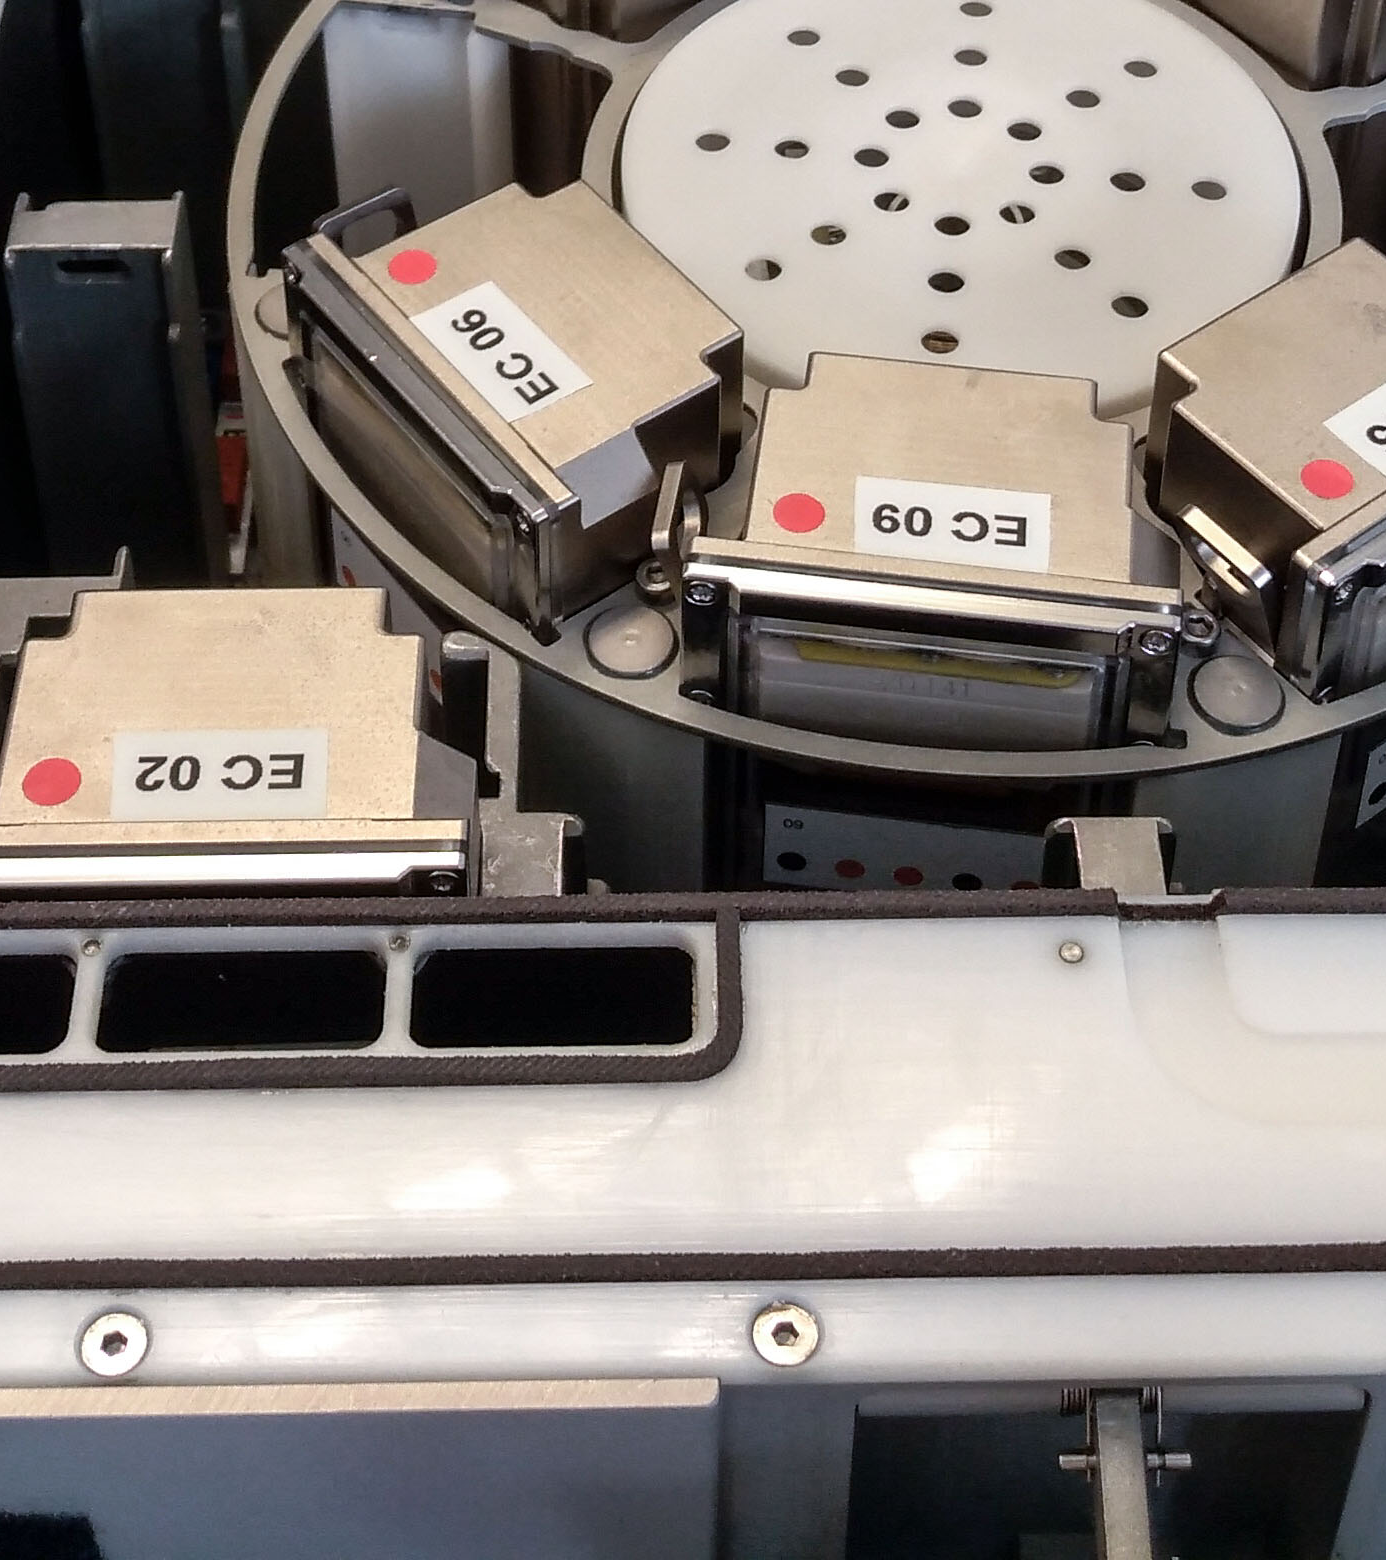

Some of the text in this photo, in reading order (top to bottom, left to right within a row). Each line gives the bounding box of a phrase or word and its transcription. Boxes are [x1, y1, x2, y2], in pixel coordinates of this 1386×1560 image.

[451, 308, 559, 406] EC 06
[872, 504, 1028, 547] EC 09
[135, 754, 304, 791] EC 02
